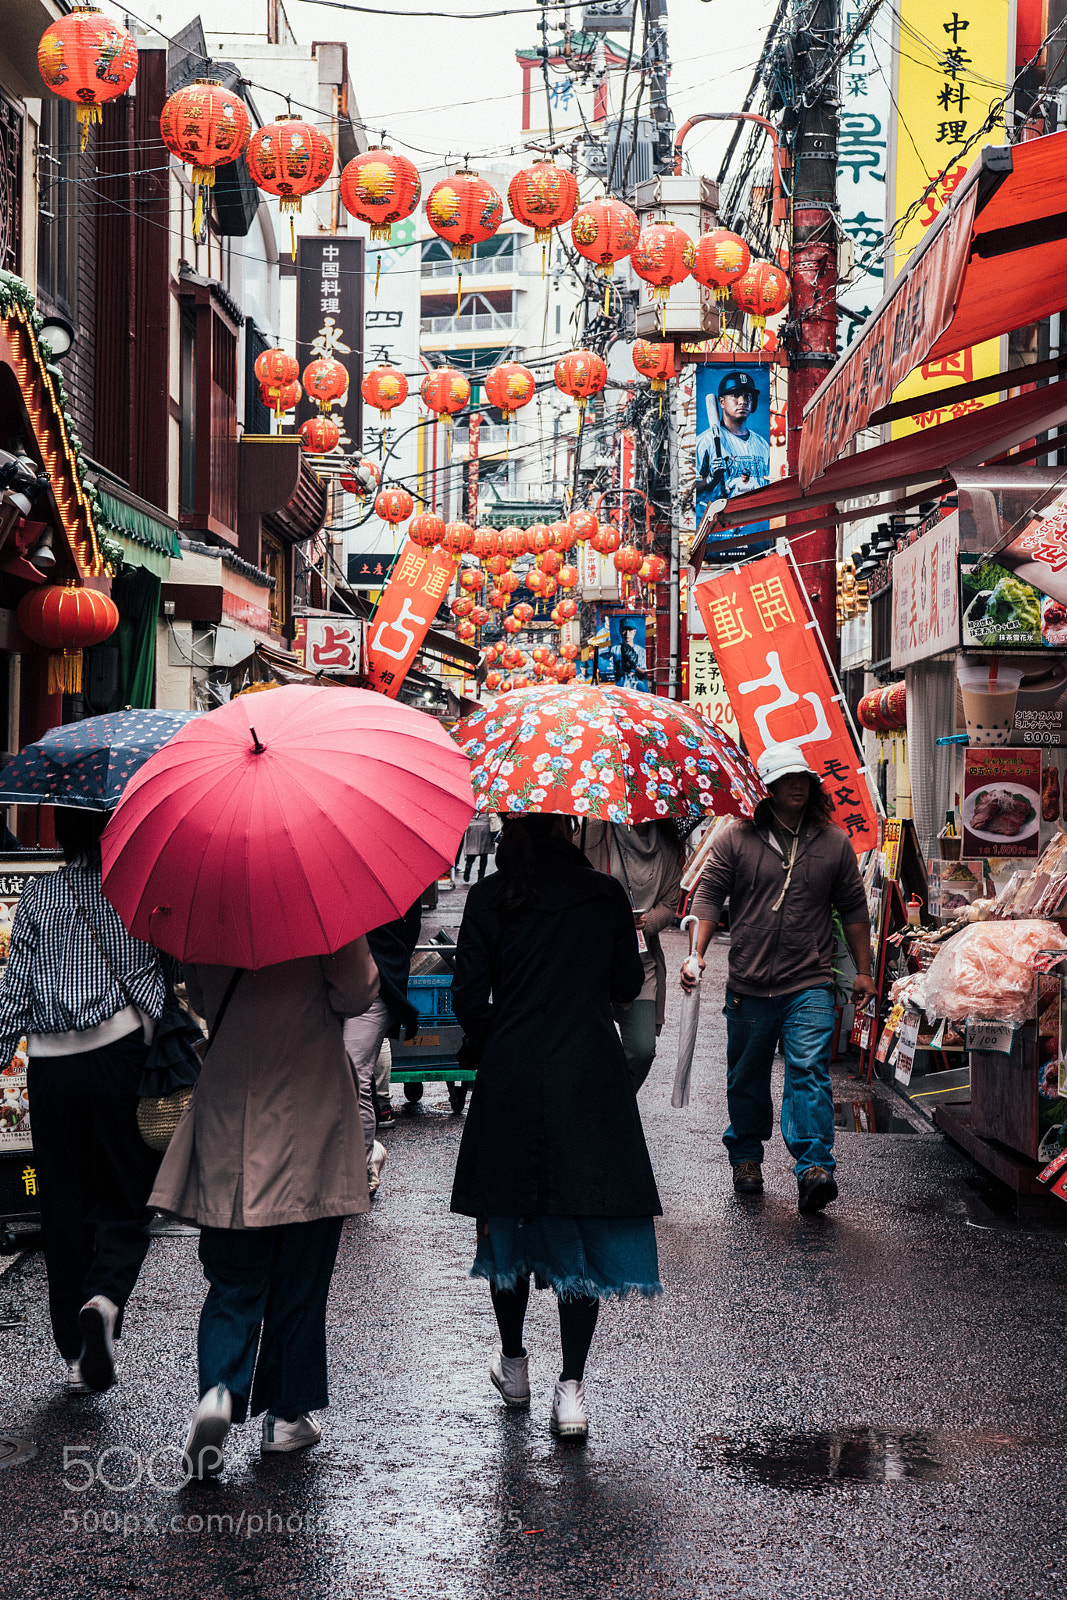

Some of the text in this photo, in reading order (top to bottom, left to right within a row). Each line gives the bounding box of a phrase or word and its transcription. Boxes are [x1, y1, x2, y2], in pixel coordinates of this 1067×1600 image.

[935, 12, 972, 145] 中華料理
[320, 244, 342, 314] 中国料理
[396, 552, 450, 599] 開運
[312, 624, 354, 668] 占
[371, 597, 426, 661] 占
[694, 667, 720, 681] ご予
[1014, 720, 1062, 729] ミルクティー
[1023, 731, 1061, 744] 300円
[969, 766, 1039, 776] 四五六チャーシュー
